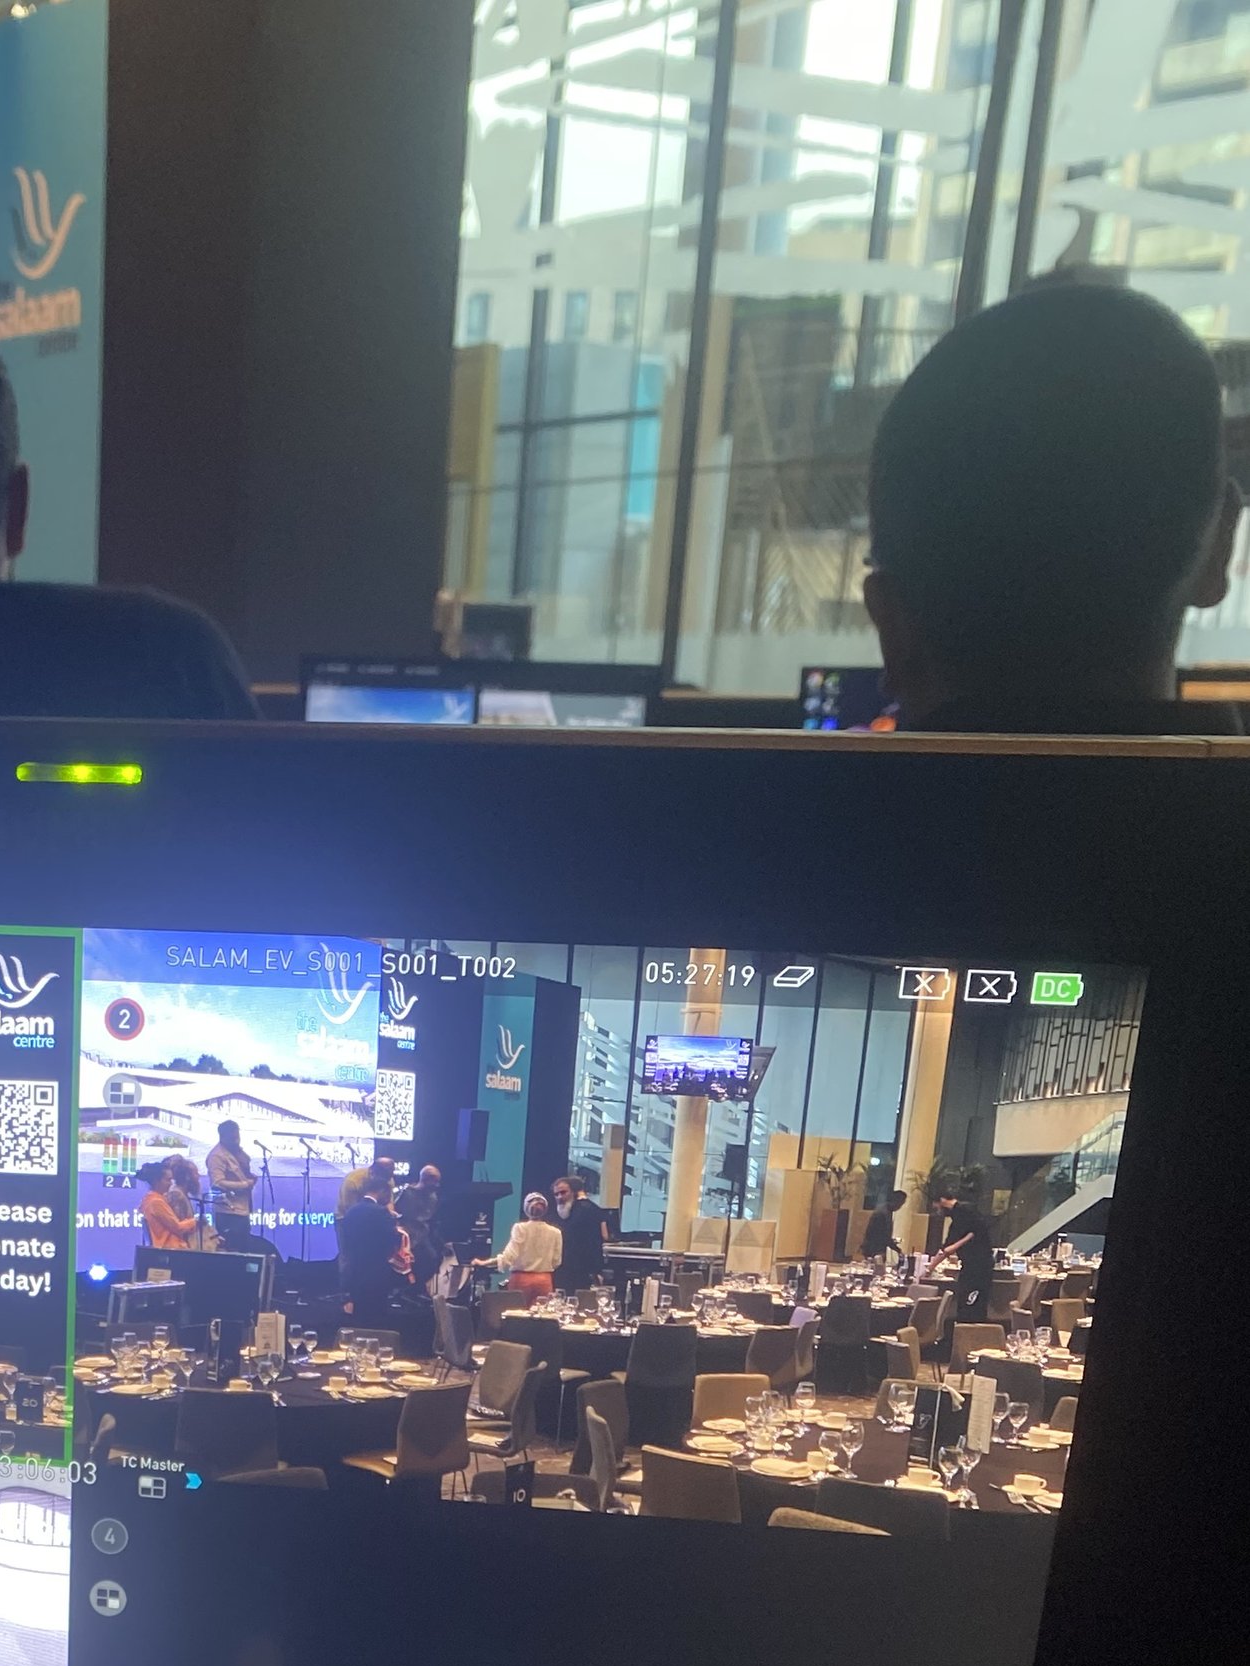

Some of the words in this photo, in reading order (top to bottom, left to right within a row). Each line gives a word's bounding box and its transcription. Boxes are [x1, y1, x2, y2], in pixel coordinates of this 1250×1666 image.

[645, 962, 755, 987] 05:27:19
[1040, 979, 1072, 999] DC
[119, 1009, 130, 1029] 2
[13, 1033, 55, 1050] centre
[105, 1176, 114, 1188] 2
[121, 1178, 132, 1188] A
[97, 1209, 131, 1228] that
[278, 1207, 296, 1226] for
[120, 1455, 139, 1469] TC
[141, 1457, 186, 1473] Master
[103, 1527, 117, 1545] 4
